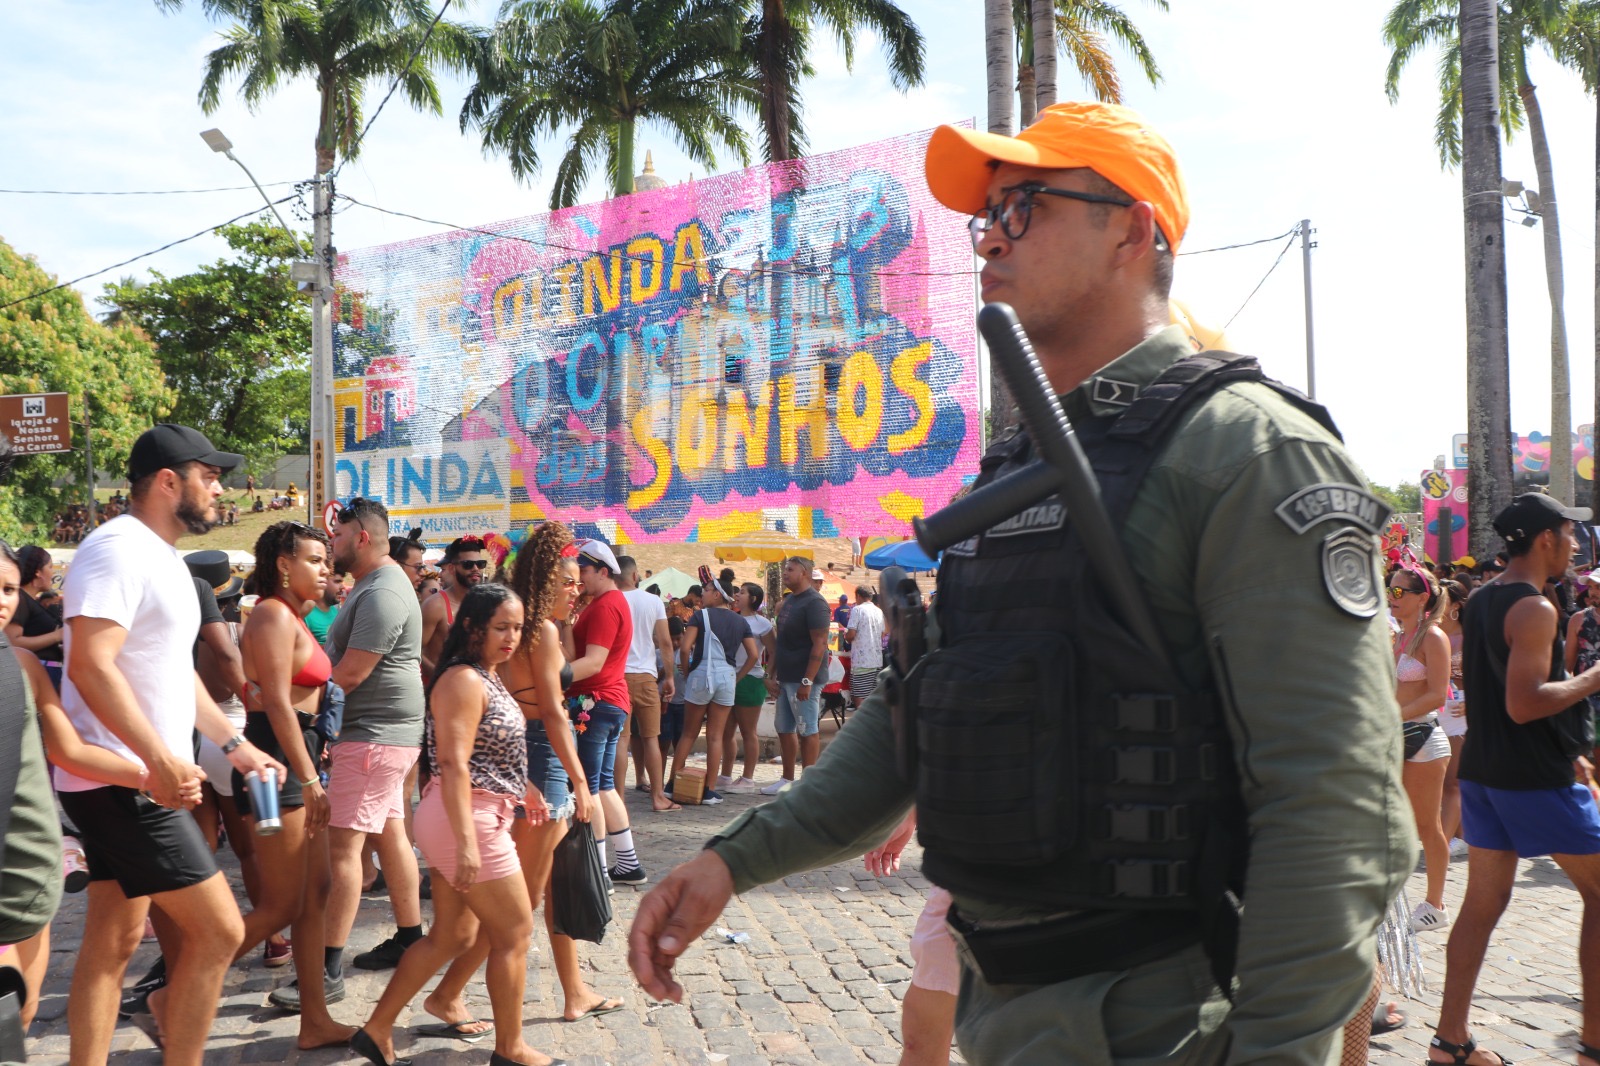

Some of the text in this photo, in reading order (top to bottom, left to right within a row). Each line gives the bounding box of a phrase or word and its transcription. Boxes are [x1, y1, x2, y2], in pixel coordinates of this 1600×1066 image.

[492, 222, 713, 341] OLINDA
[11, 418, 43, 428] Igreja
[626, 342, 937, 511] SONHOS
[18, 426, 52, 434] Nossa
[13, 434, 59, 443] Senhora
[26, 443, 63, 451] Carmo
[419, 514, 499, 532] MUNICIPAL
